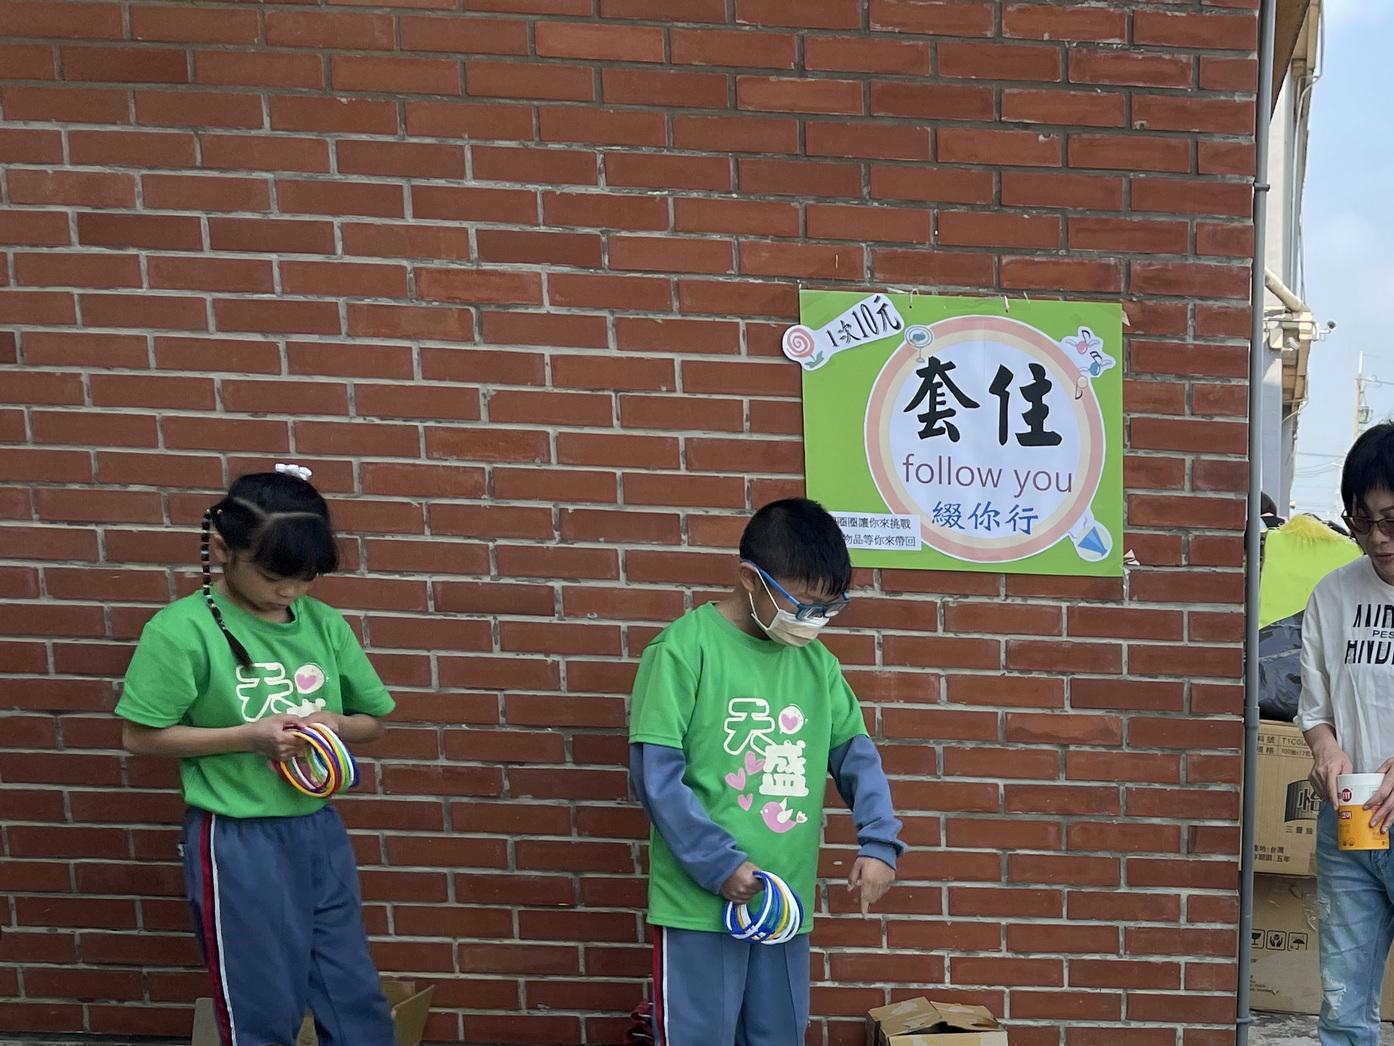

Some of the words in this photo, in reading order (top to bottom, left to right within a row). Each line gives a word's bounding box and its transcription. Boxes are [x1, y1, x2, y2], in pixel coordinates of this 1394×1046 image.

[826, 295, 901, 347] 1次10元
[903, 356, 1063, 446] 套住
[902, 453, 1002, 488] follow
[1013, 469, 1073, 498] you
[834, 516, 912, 530] 圈圈讓你來挑戰
[931, 500, 1039, 535] 綴你行
